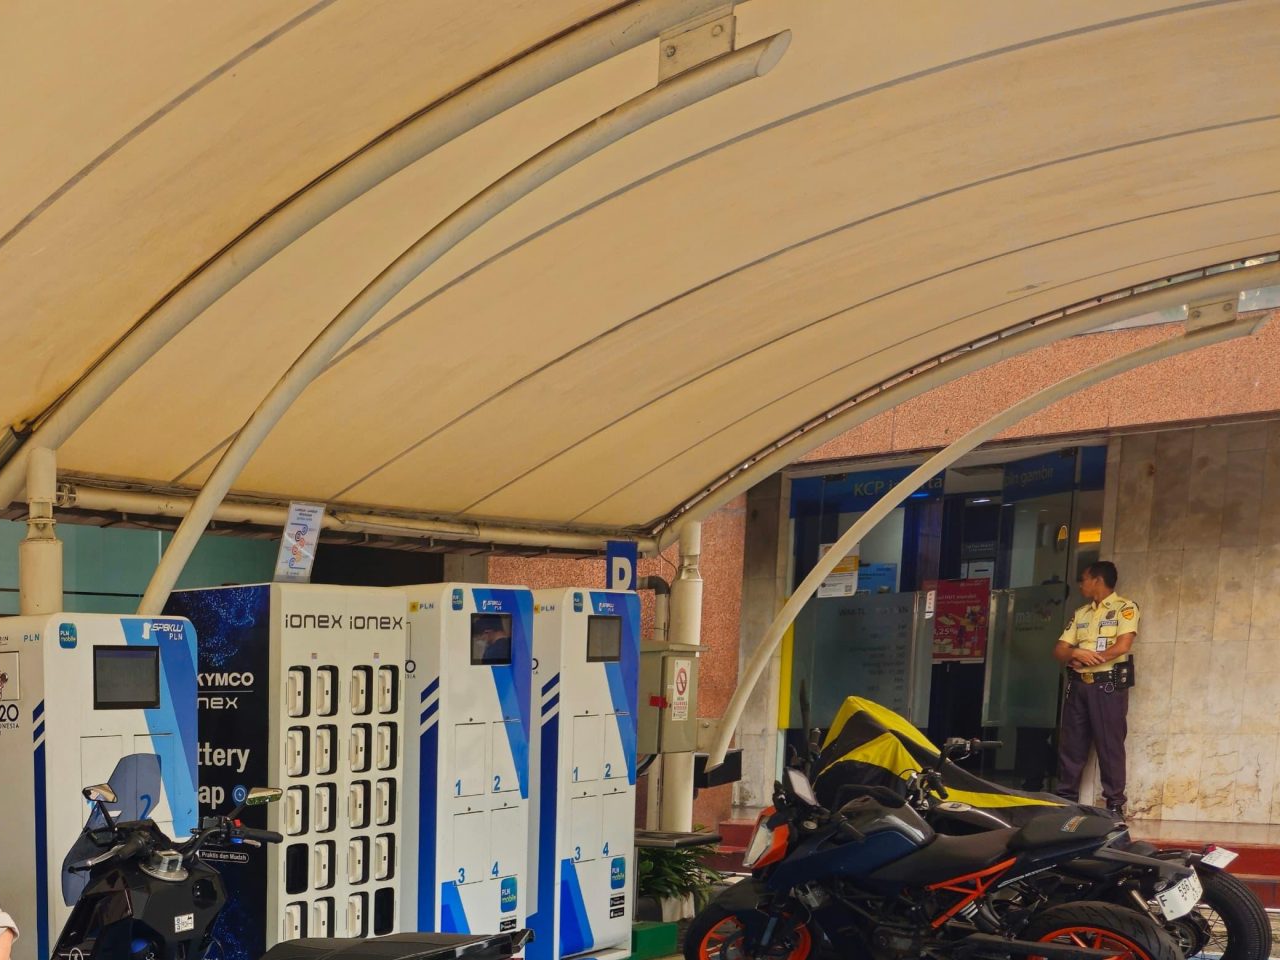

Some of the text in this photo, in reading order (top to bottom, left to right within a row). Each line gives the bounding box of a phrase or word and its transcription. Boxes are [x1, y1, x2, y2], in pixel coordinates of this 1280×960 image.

[285, 614, 342, 629] ionex
[349, 615, 404, 630] ionex
[23, 633, 40, 642] PLN
[197, 697, 238, 710] nex
[197, 742, 250, 773] ttery
[573, 766, 579, 782] 1
[604, 763, 612, 777] 2
[455, 779, 461, 796] 1
[493, 775, 501, 791] 2
[198, 786, 225, 809] ap
[140, 794, 152, 820] 2
[574, 846, 581, 860] 3
[602, 842, 609, 856] 4
[458, 867, 465, 884] 3
[491, 861, 499, 877] 4
